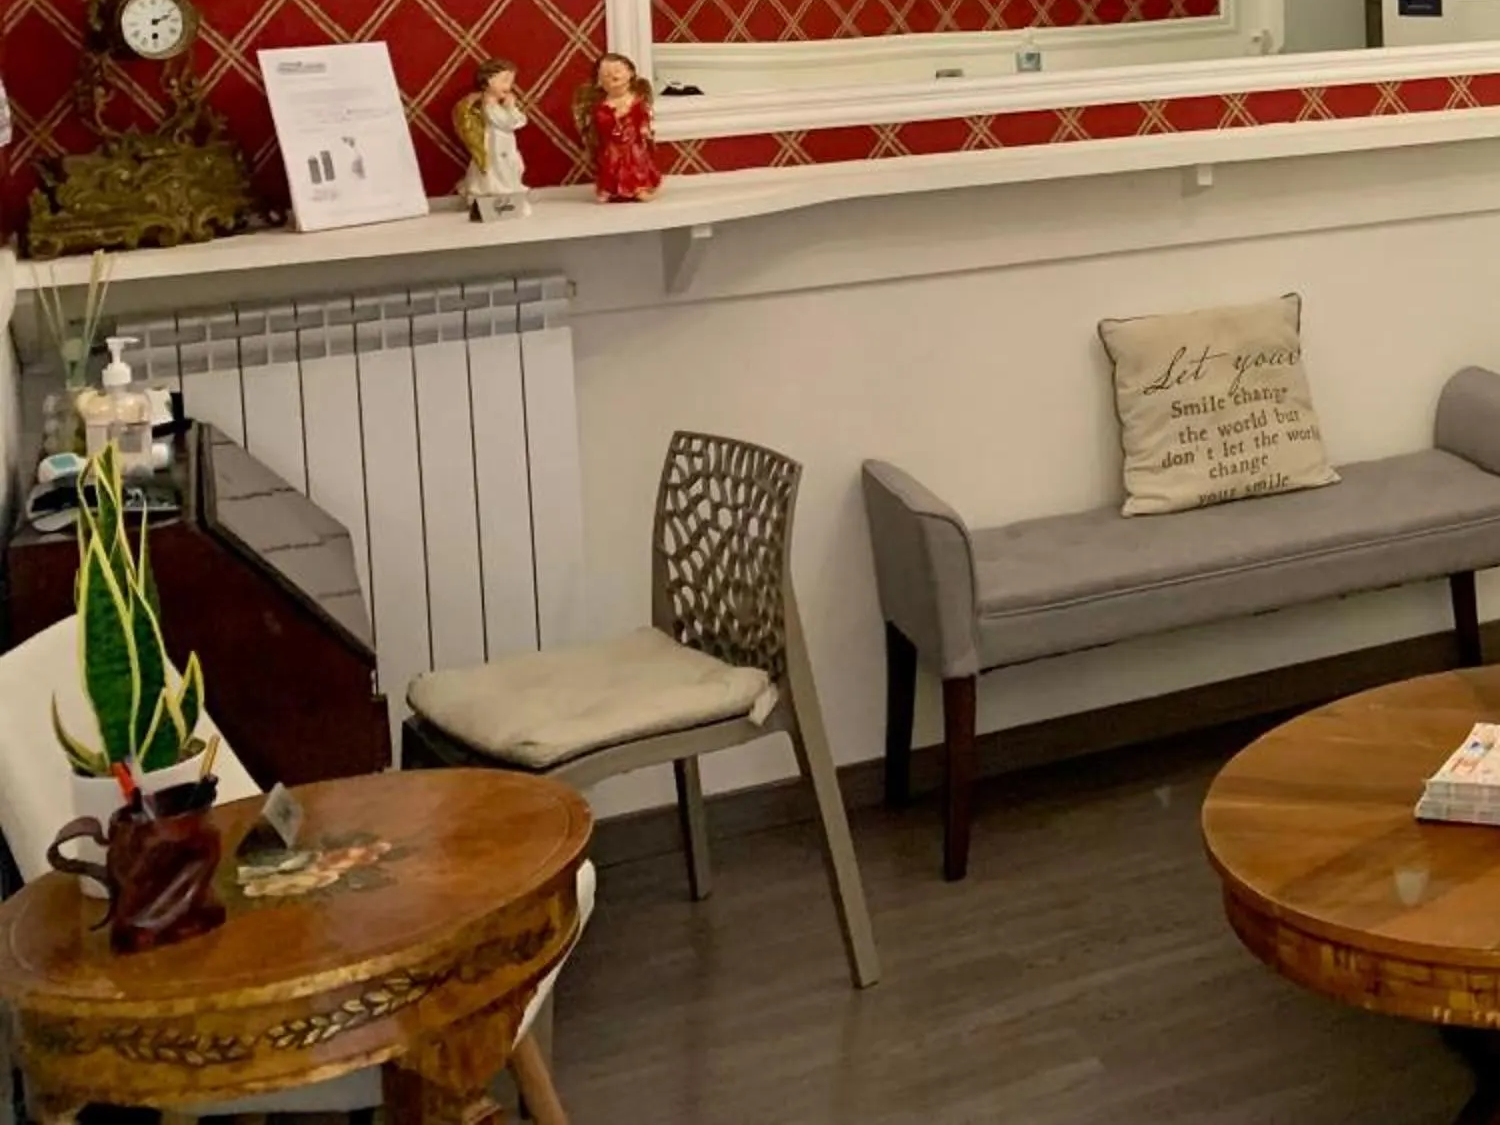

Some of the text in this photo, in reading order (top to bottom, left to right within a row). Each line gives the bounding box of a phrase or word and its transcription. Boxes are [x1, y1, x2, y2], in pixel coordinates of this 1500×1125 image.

[1143, 346, 1229, 395] Let
[1171, 395, 1226, 419] Smile
[1178, 427, 1208, 445] the
[1217, 410, 1268, 438] world
[1223, 442, 1245, 458] let
[1253, 431, 1279, 447] the
[1208, 454, 1269, 479] change
